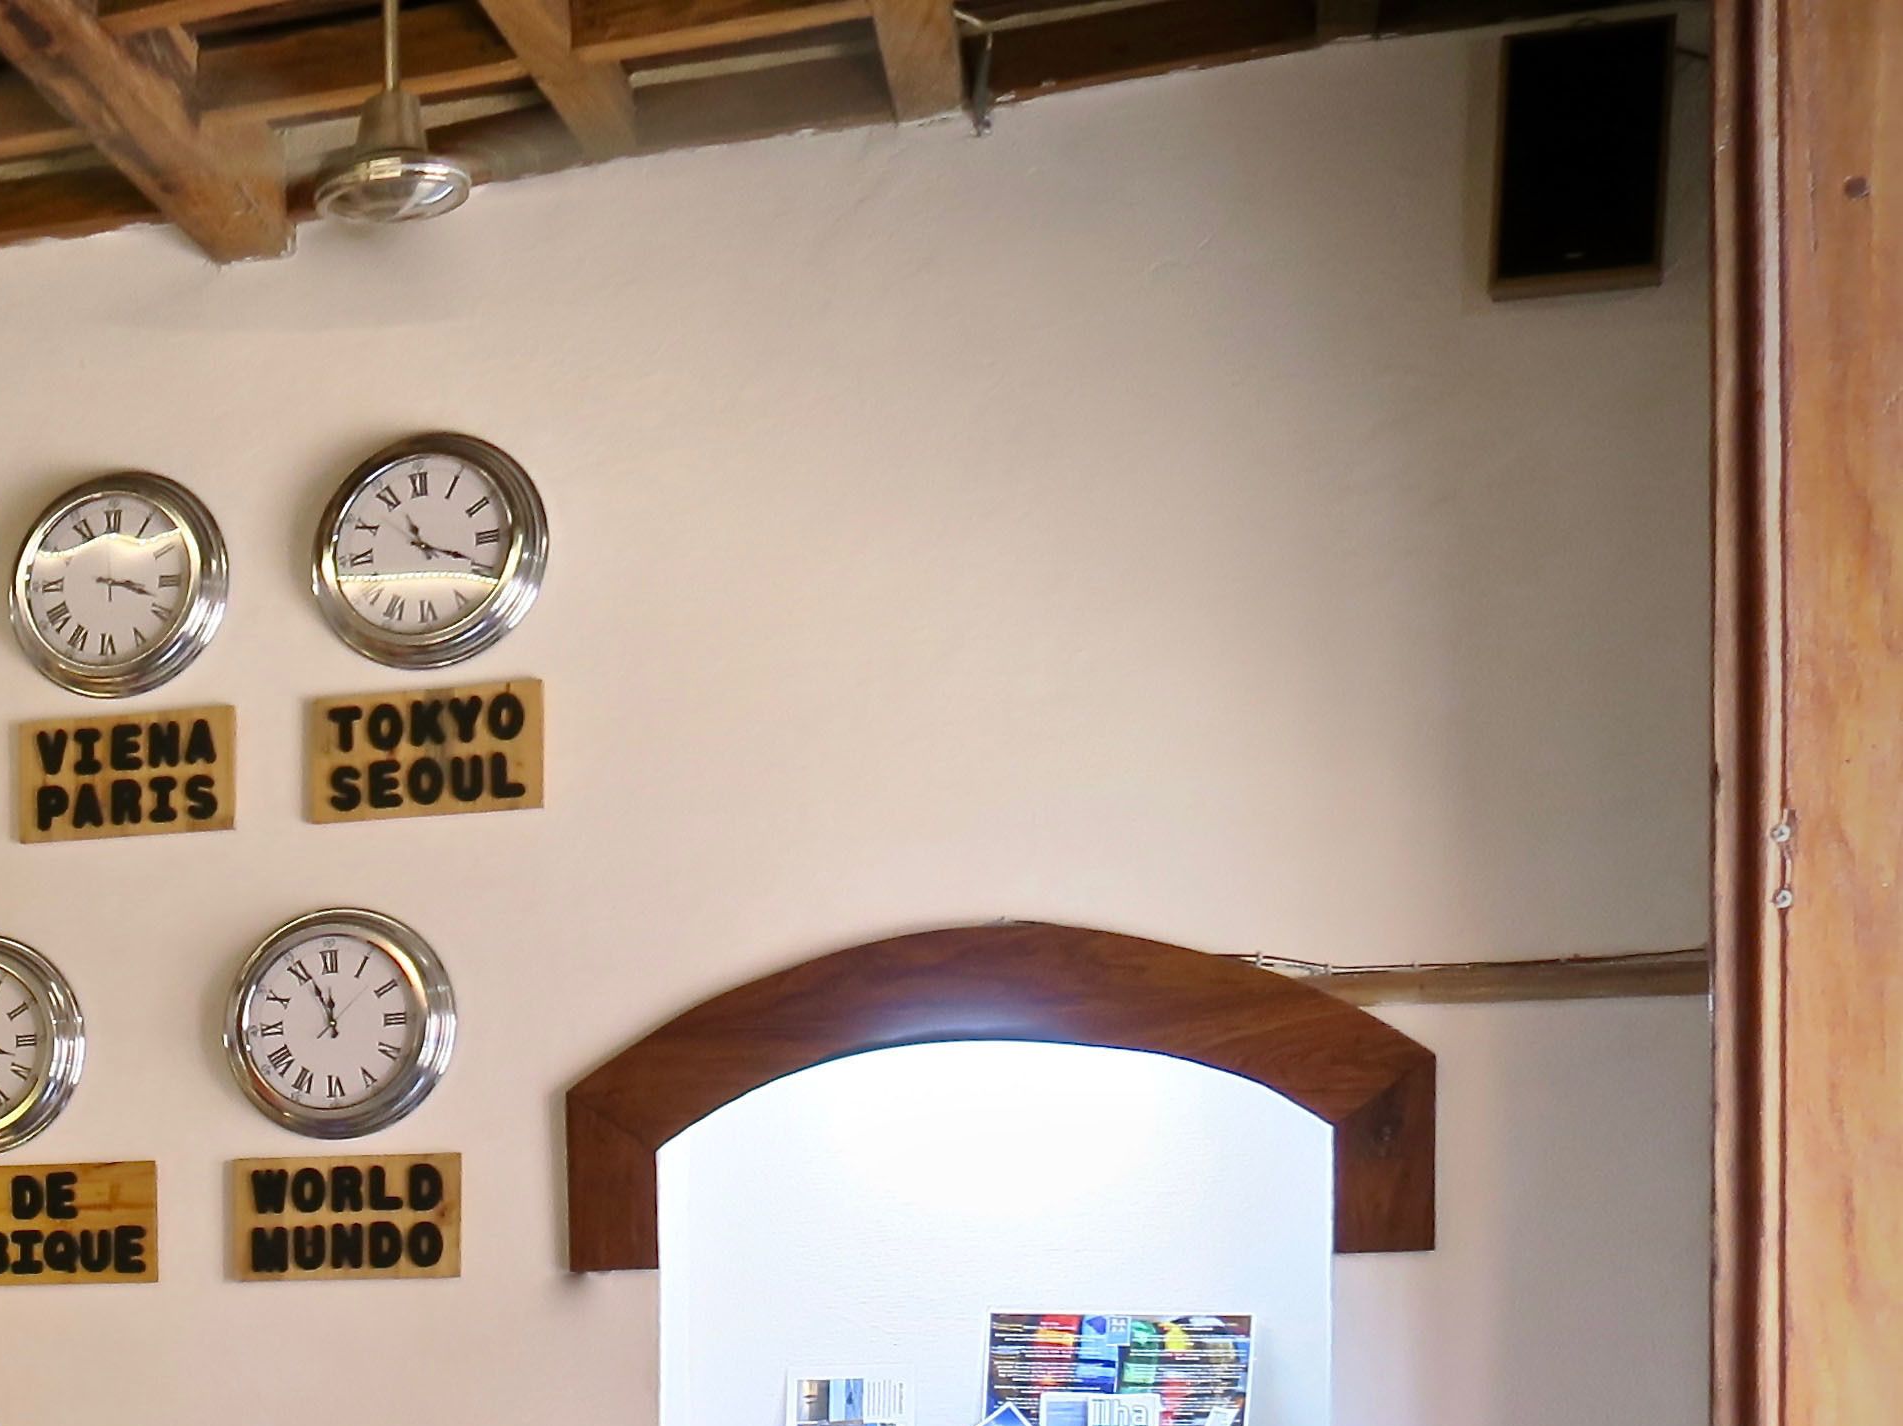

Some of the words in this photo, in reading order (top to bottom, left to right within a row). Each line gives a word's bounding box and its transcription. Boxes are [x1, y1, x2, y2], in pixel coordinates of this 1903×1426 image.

[36, 719, 217, 775] VIENA
[327, 692, 525, 752] TOKYO
[37, 774, 218, 831] PARIS
[330, 752, 526, 811] SEOUL
[10, 1171, 78, 1220] DE
[251, 1163, 443, 1214] WORLD
[251, 1221, 443, 1273] MUNDO
